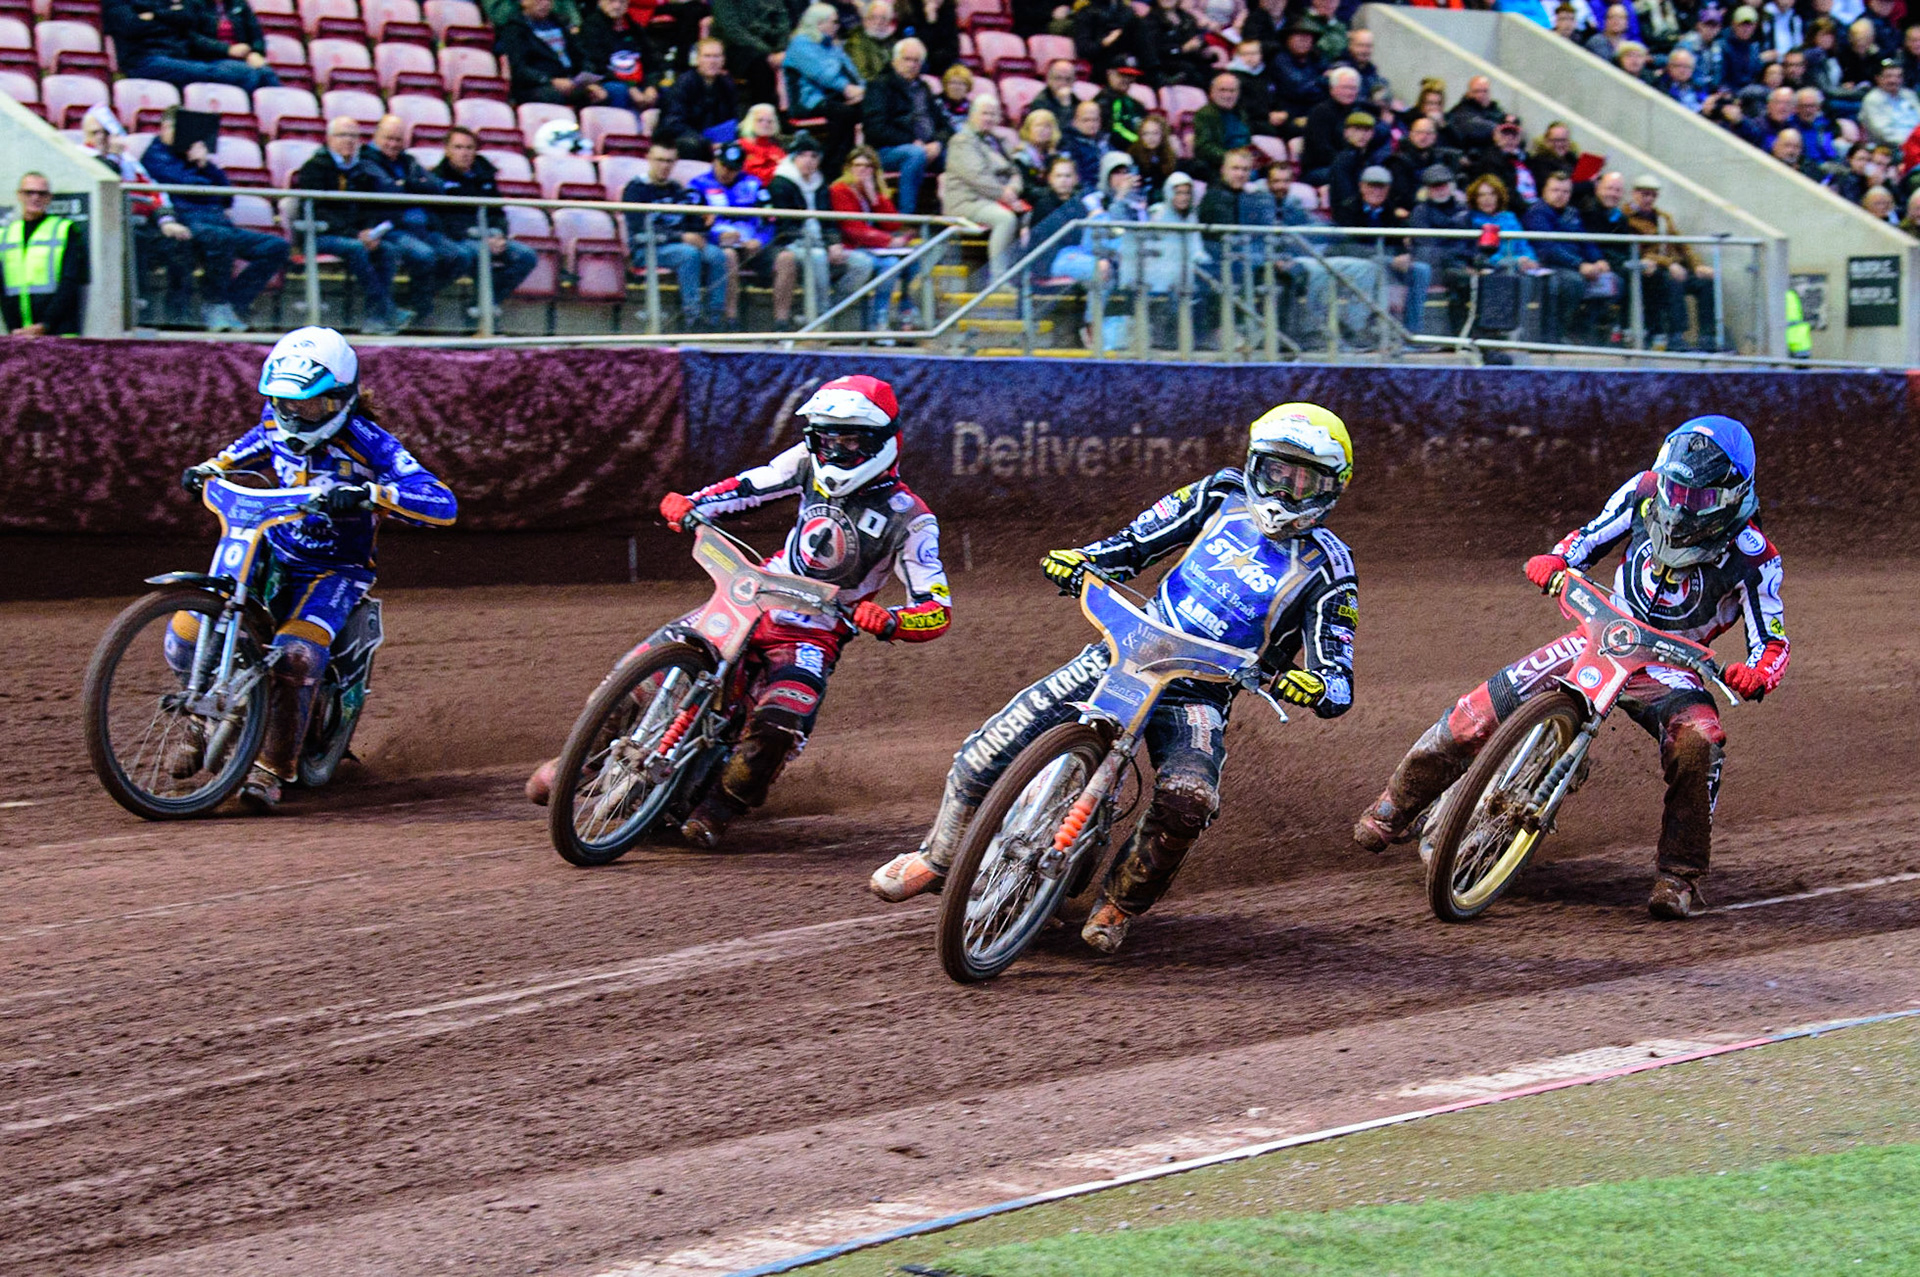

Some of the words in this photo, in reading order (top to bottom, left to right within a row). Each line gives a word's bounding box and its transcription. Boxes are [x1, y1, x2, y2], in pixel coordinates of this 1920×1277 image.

[1216, 582, 1232, 599] &
[963, 702, 1036, 774] HANSEN
[1028, 690, 1054, 712] &
[1045, 649, 1109, 700] KRUSE
